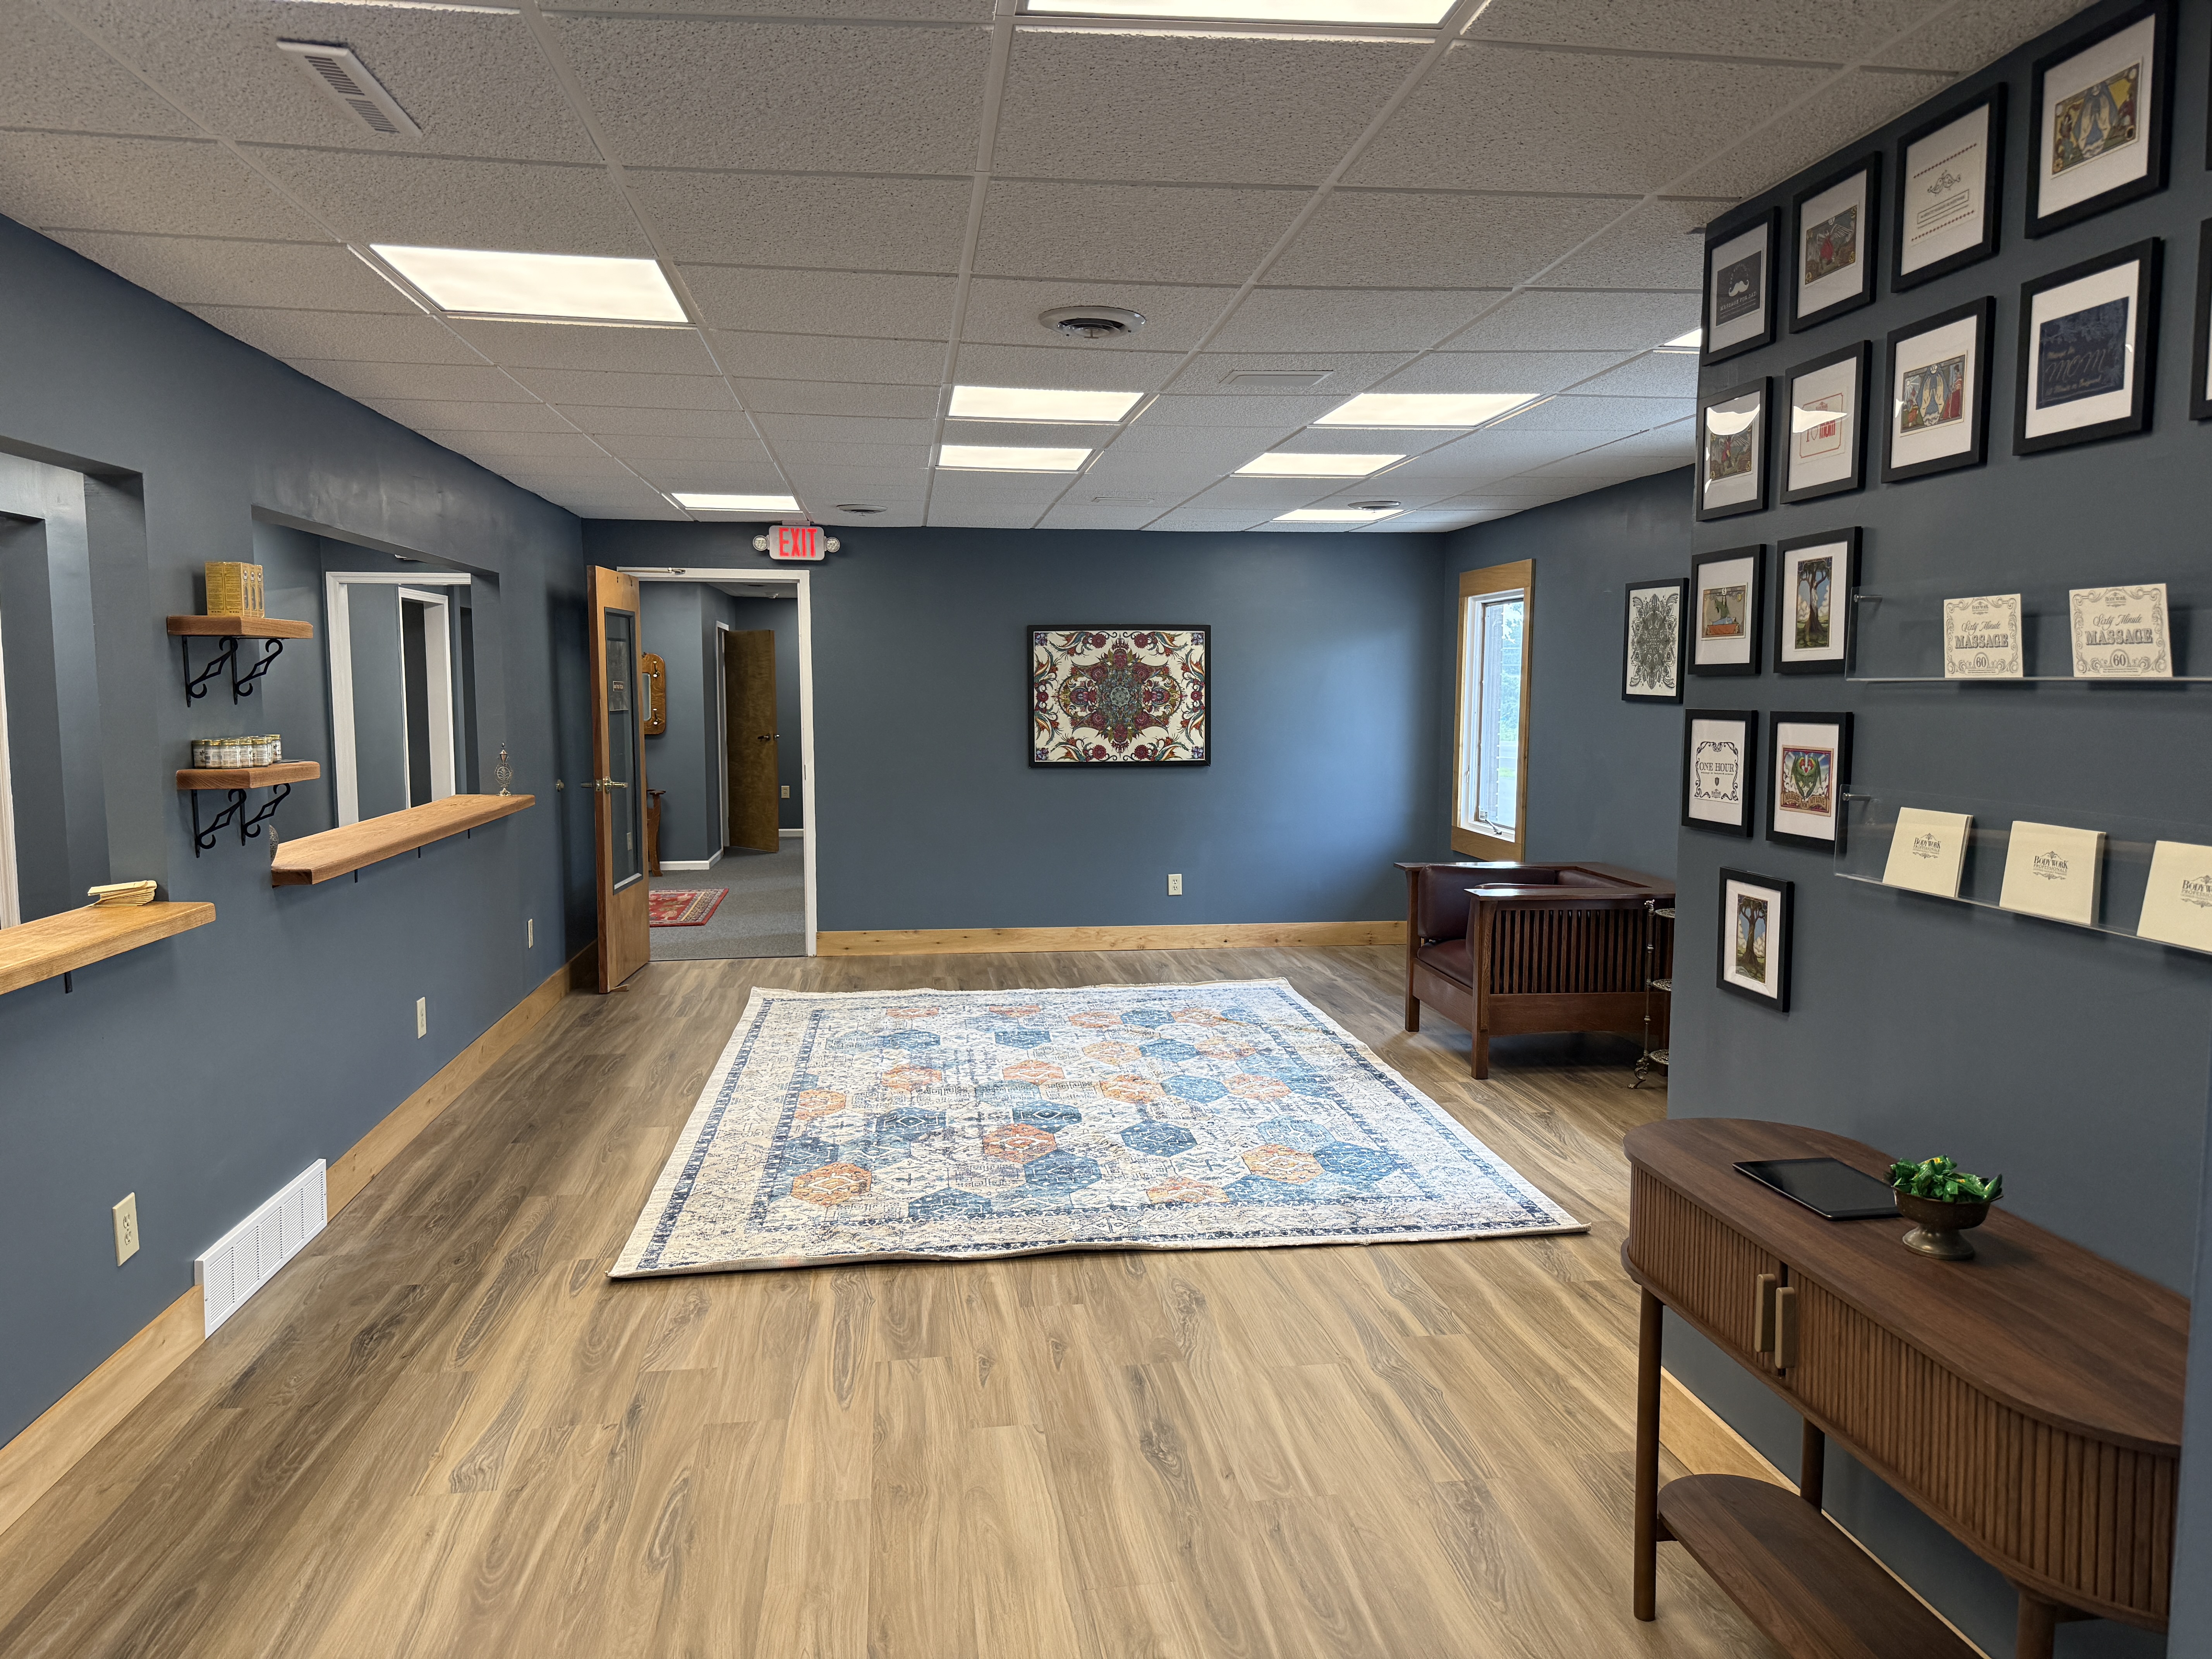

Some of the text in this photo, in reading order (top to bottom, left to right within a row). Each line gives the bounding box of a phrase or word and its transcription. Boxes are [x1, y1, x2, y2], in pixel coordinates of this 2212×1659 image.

[778, 527, 817, 557] EXIT
[1962, 620, 2001, 635] Sixty Minute
[2093, 613, 2143, 631] Sixty Minute
[1954, 634, 2008, 649] MASSAGE
[2085, 628, 2153, 646] MASSAGE
[1976, 657, 1987, 668] 60
[2113, 654, 2126, 666] 60
[1699, 762, 1734, 772] ONE HOUR
